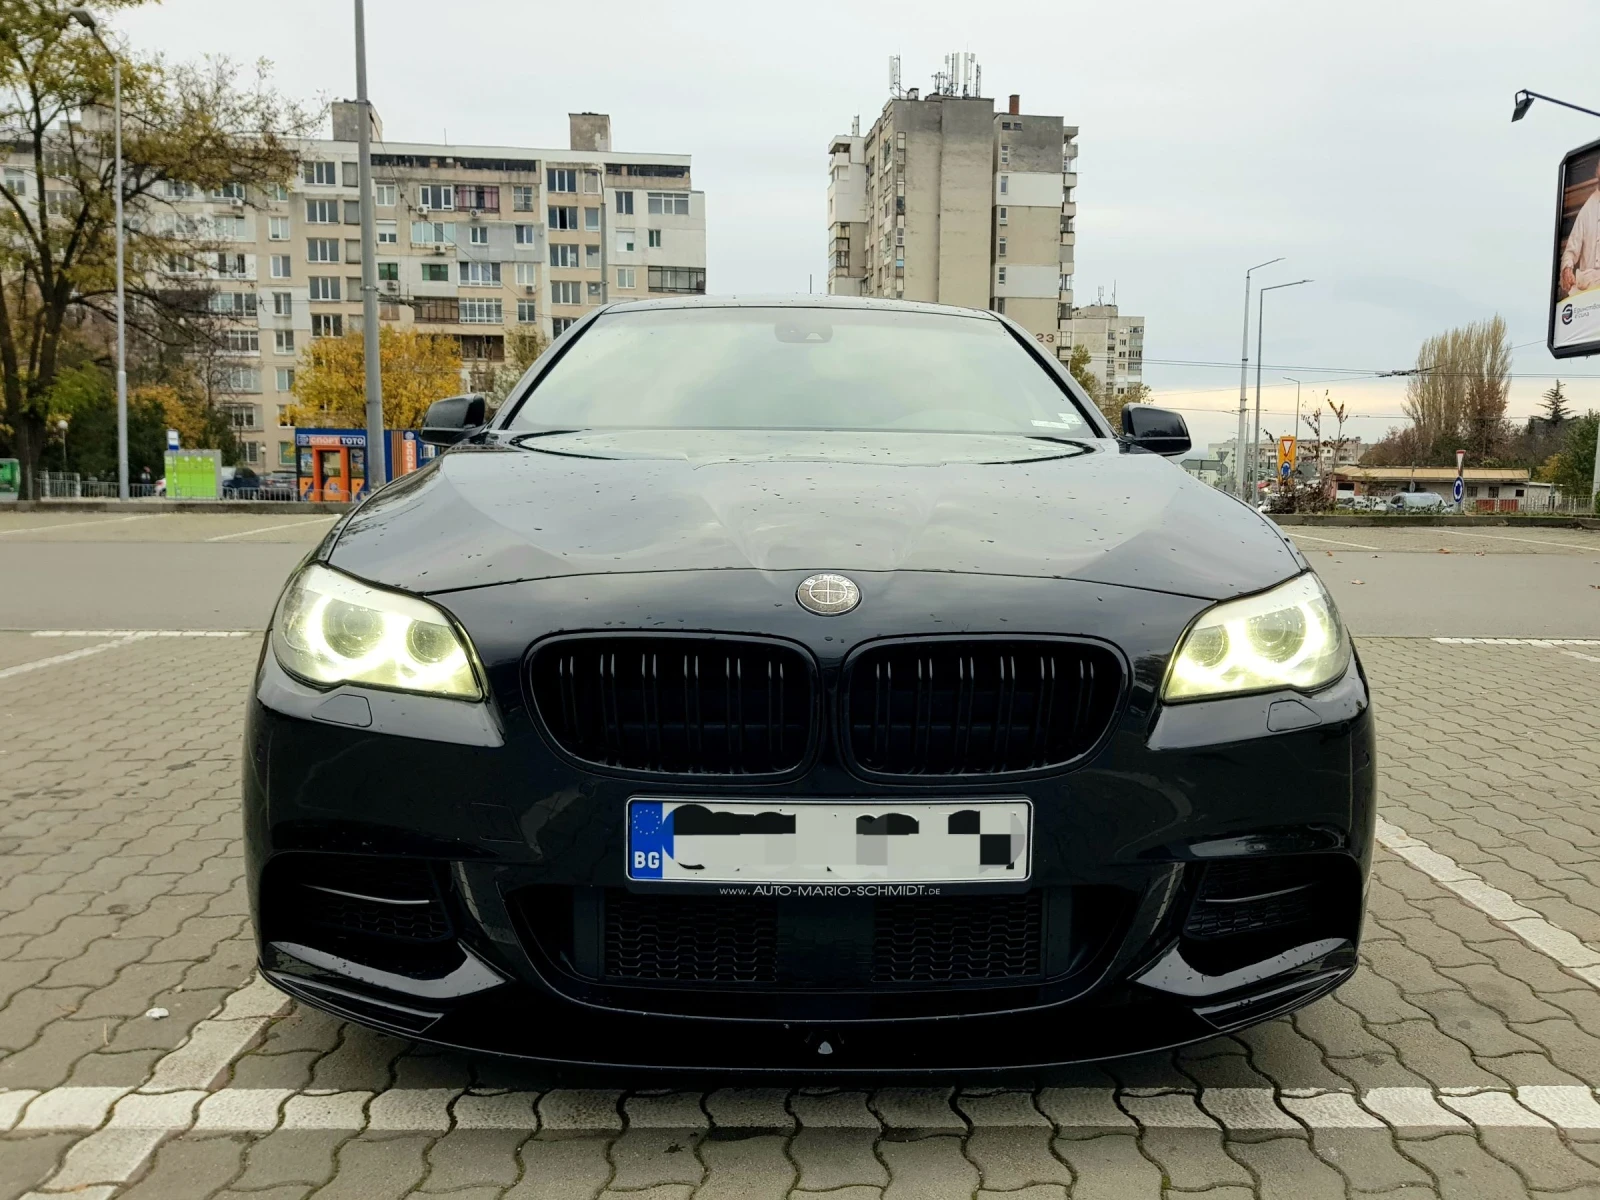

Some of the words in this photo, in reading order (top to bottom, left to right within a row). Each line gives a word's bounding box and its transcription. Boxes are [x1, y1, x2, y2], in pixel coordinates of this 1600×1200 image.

[1036, 333, 1054, 343] 23
[311, 436, 340, 445] СПОРТ
[341, 437, 363, 445] ТОТО
[634, 851, 660, 869] BG
